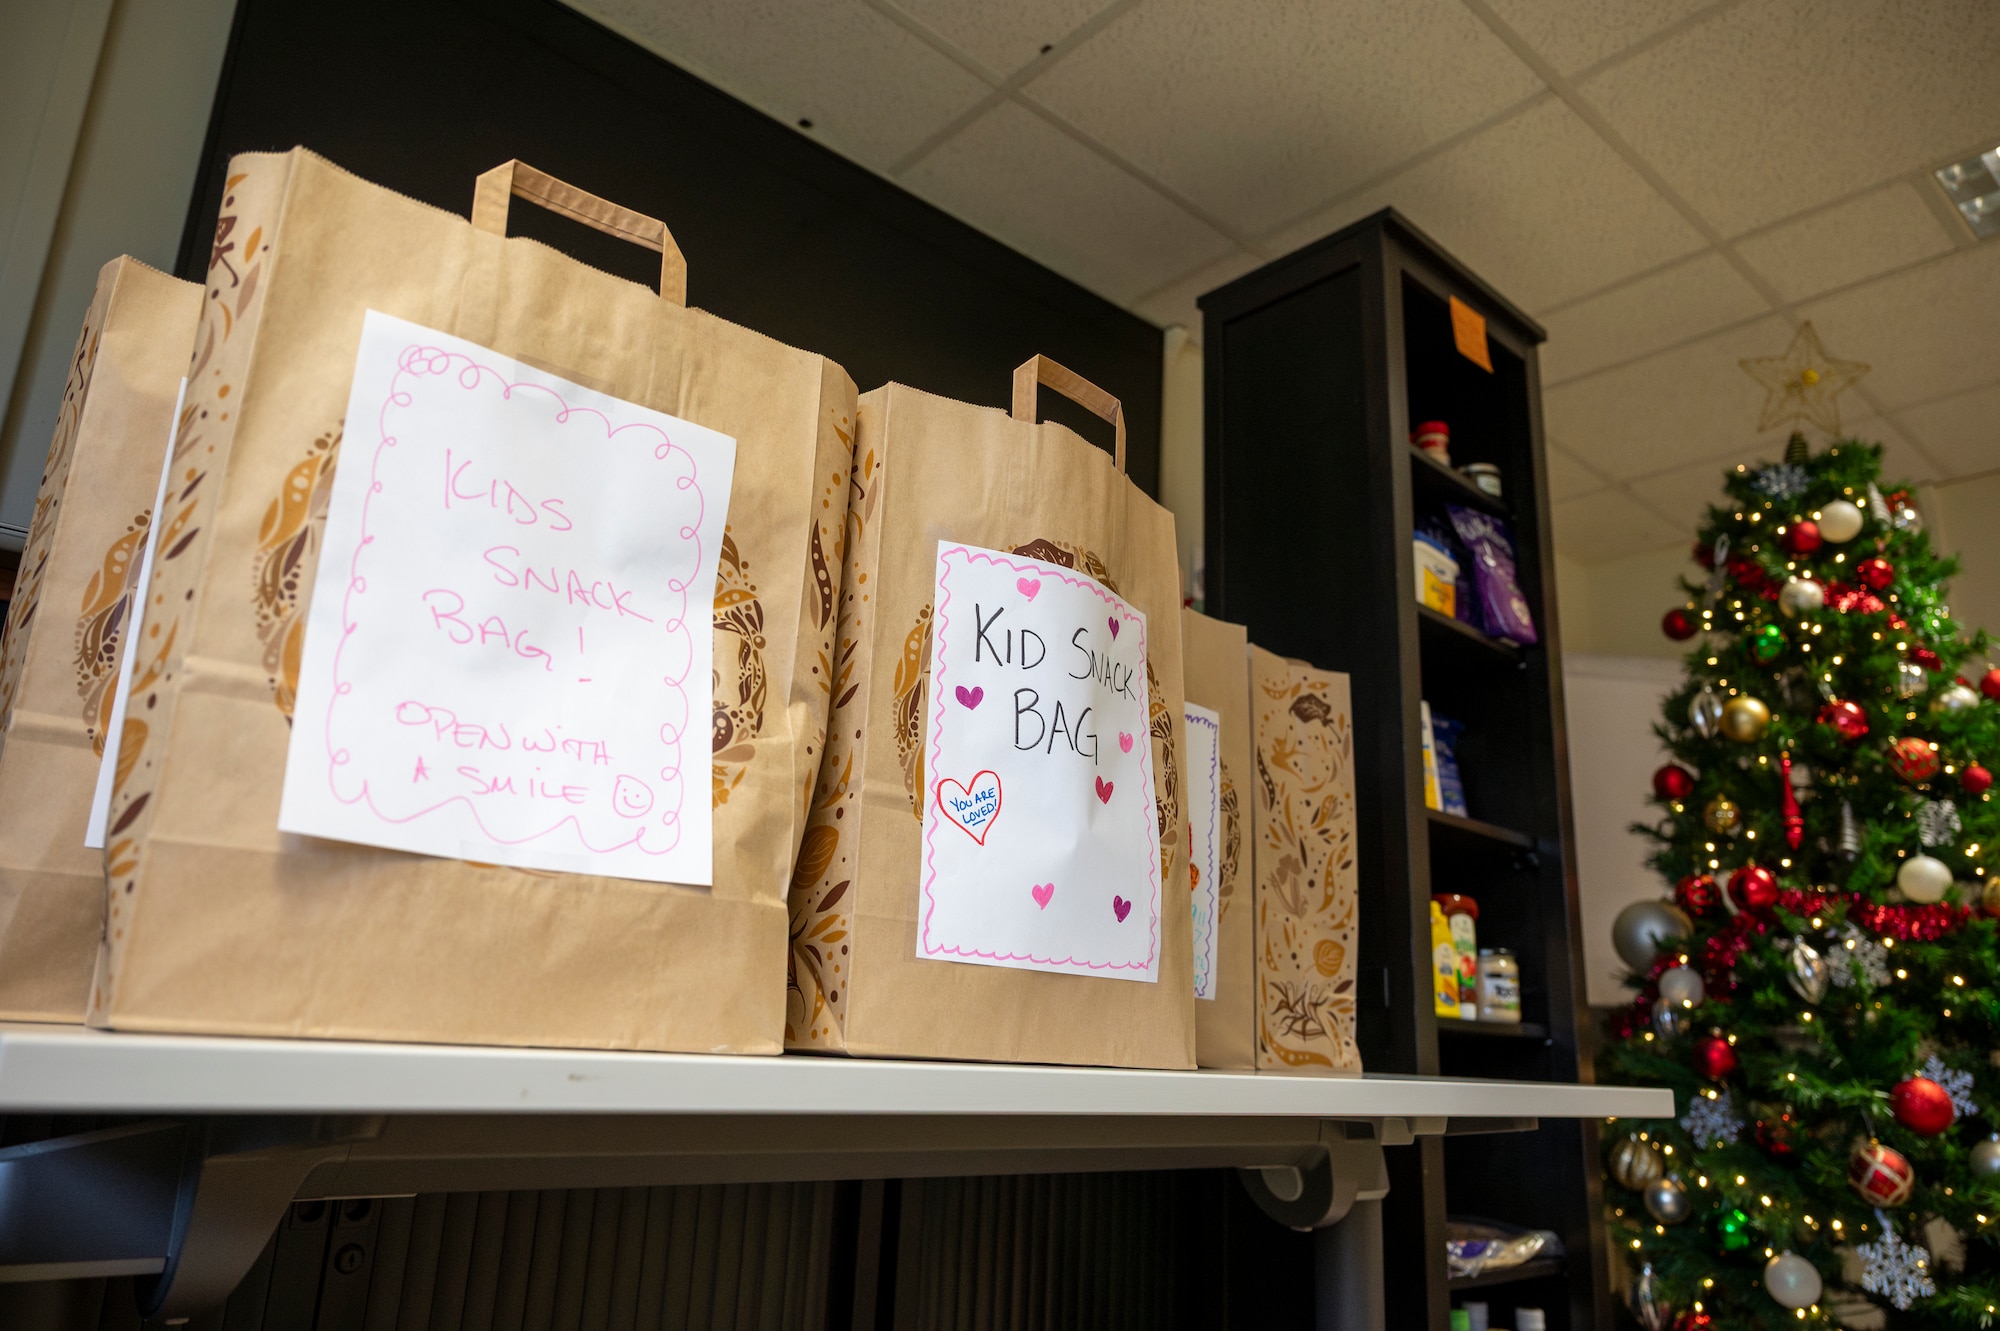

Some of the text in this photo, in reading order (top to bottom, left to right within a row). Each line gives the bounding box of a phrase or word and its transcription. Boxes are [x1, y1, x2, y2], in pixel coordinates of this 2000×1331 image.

[445, 448, 573, 532] KIDS
[483, 545, 654, 623] SNACK
[975, 603, 1136, 701] KID SNACK
[394, 700, 511, 750] OPEN
[1013, 688, 1098, 766] BAG
[412, 755, 431, 783] A
[949, 787, 996, 812] YOU ARE
[962, 798, 998, 824] LOVED!
